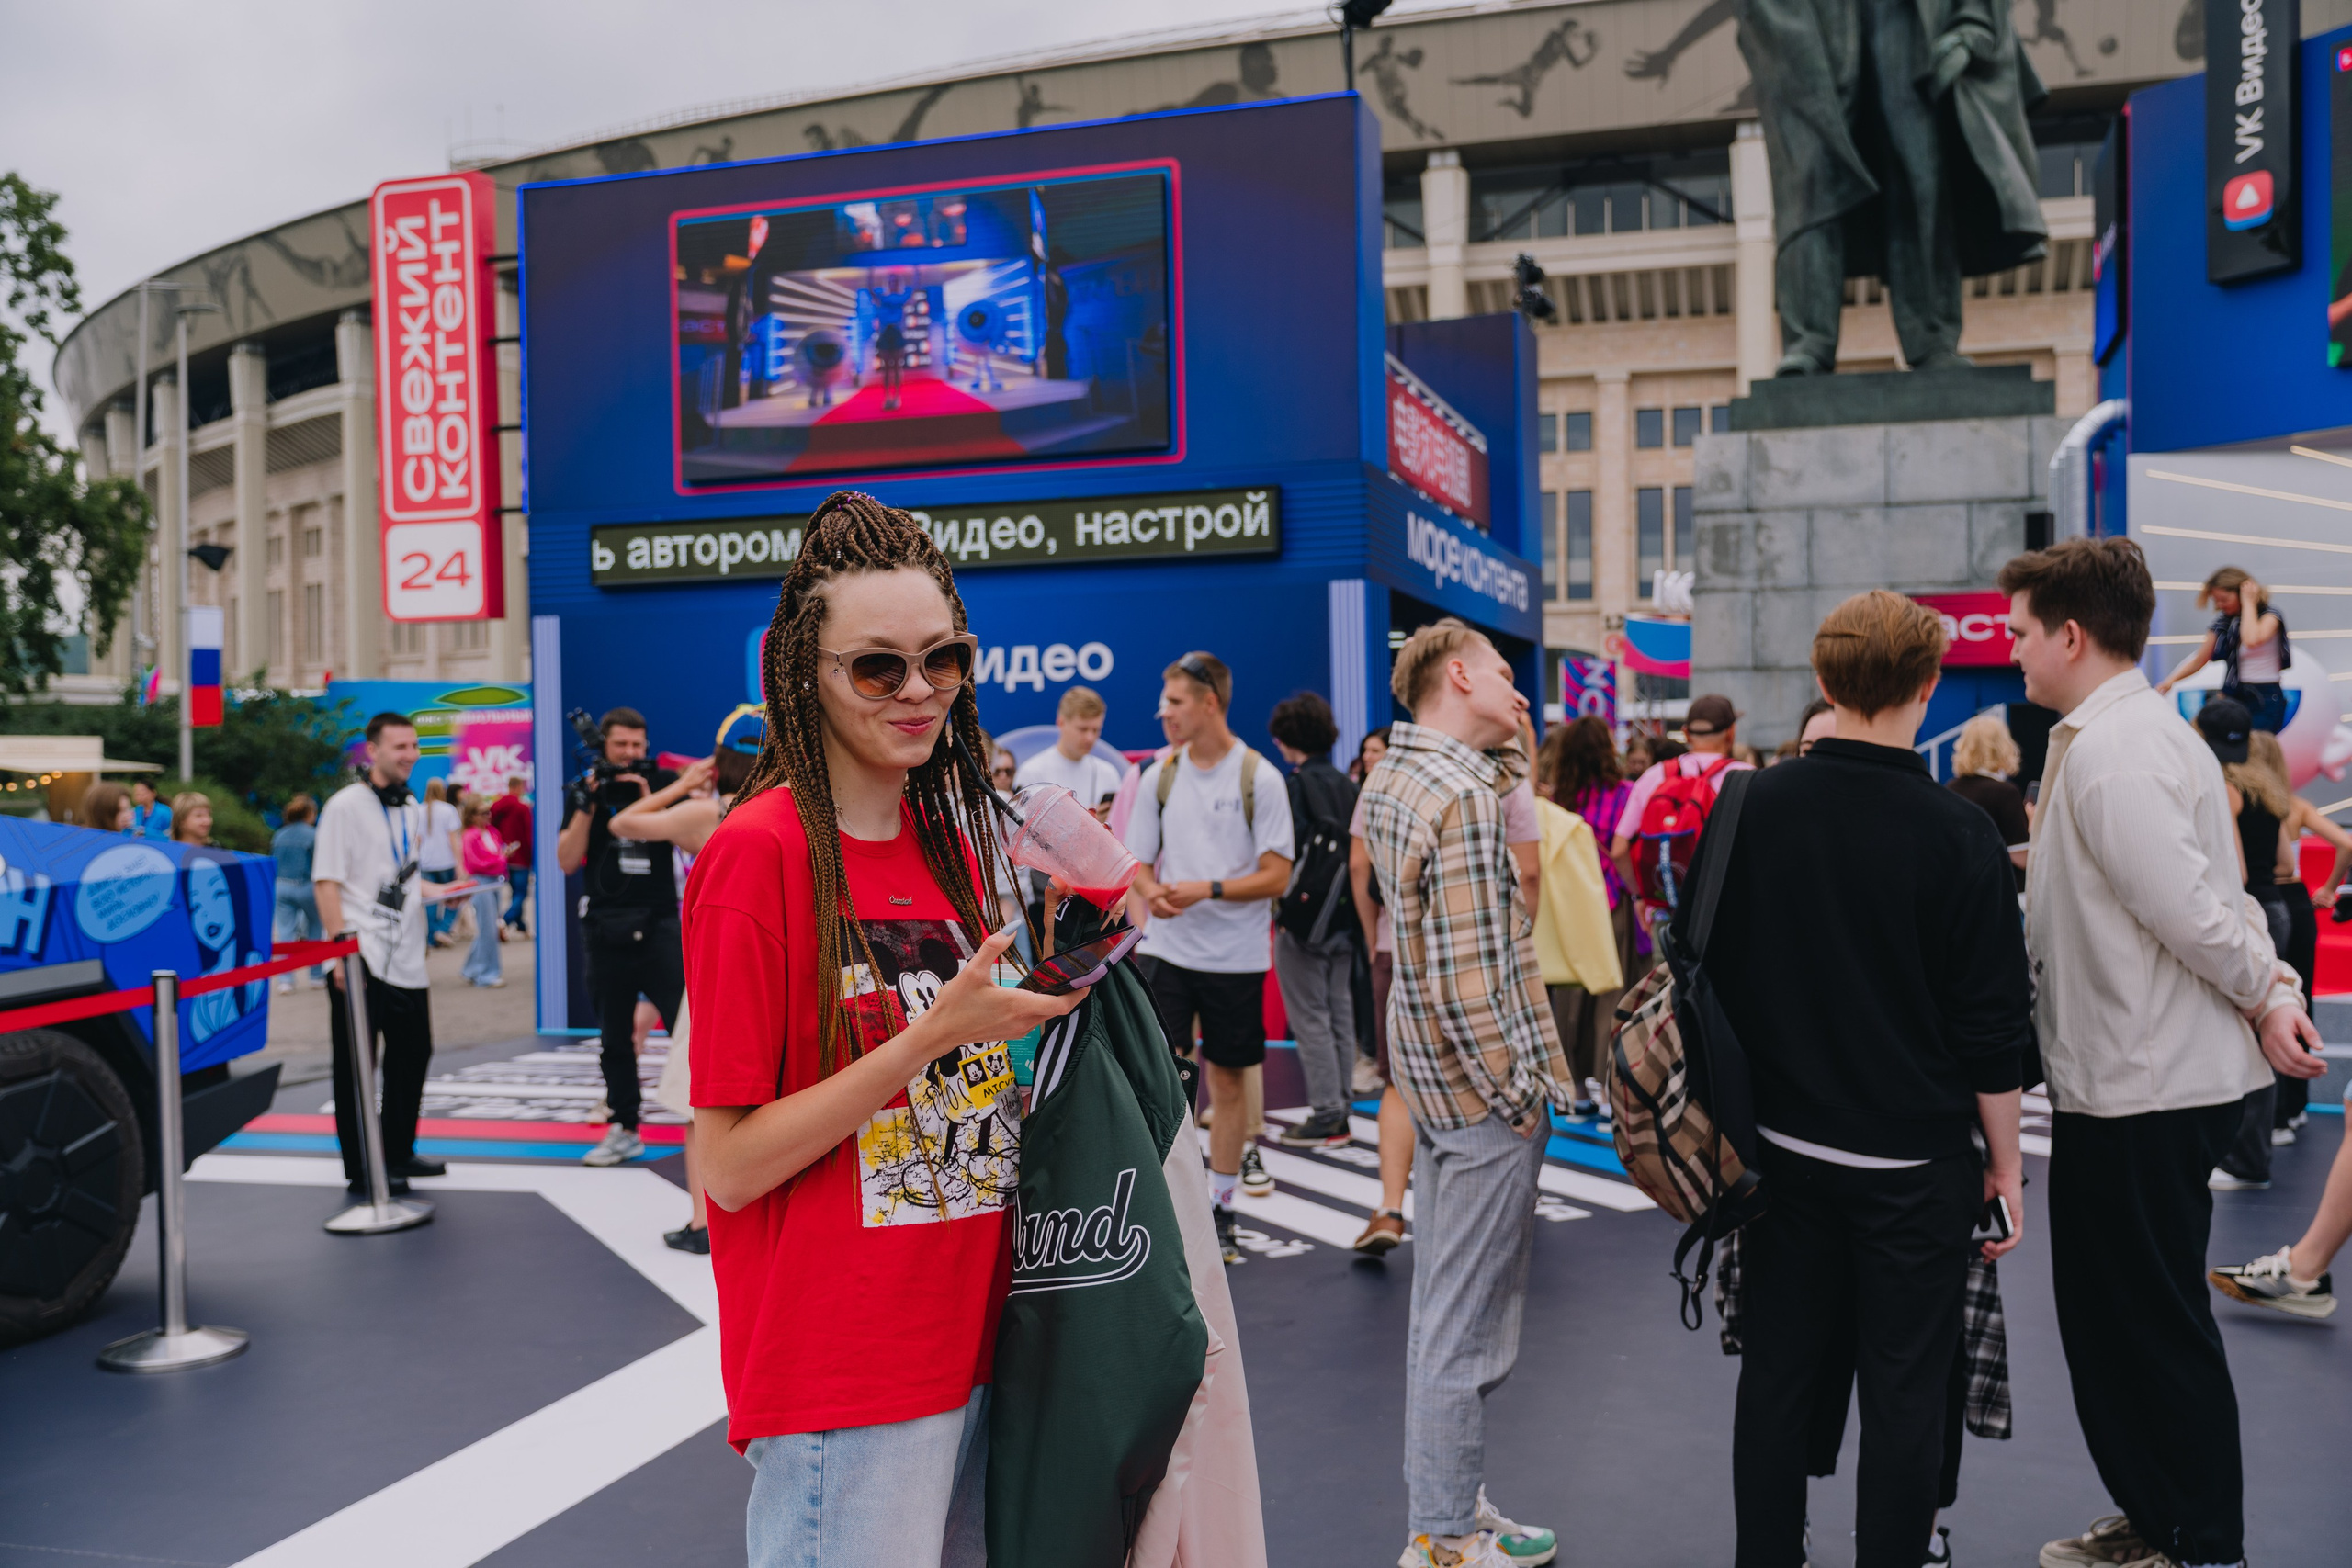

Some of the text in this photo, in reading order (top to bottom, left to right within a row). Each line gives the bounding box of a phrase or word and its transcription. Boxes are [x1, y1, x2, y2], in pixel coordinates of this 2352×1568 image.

[2235, 106, 2264, 164] VK
[626, 528, 803, 575] автором
[1075, 491, 1270, 551] настрой
[400, 550, 472, 590] 24
